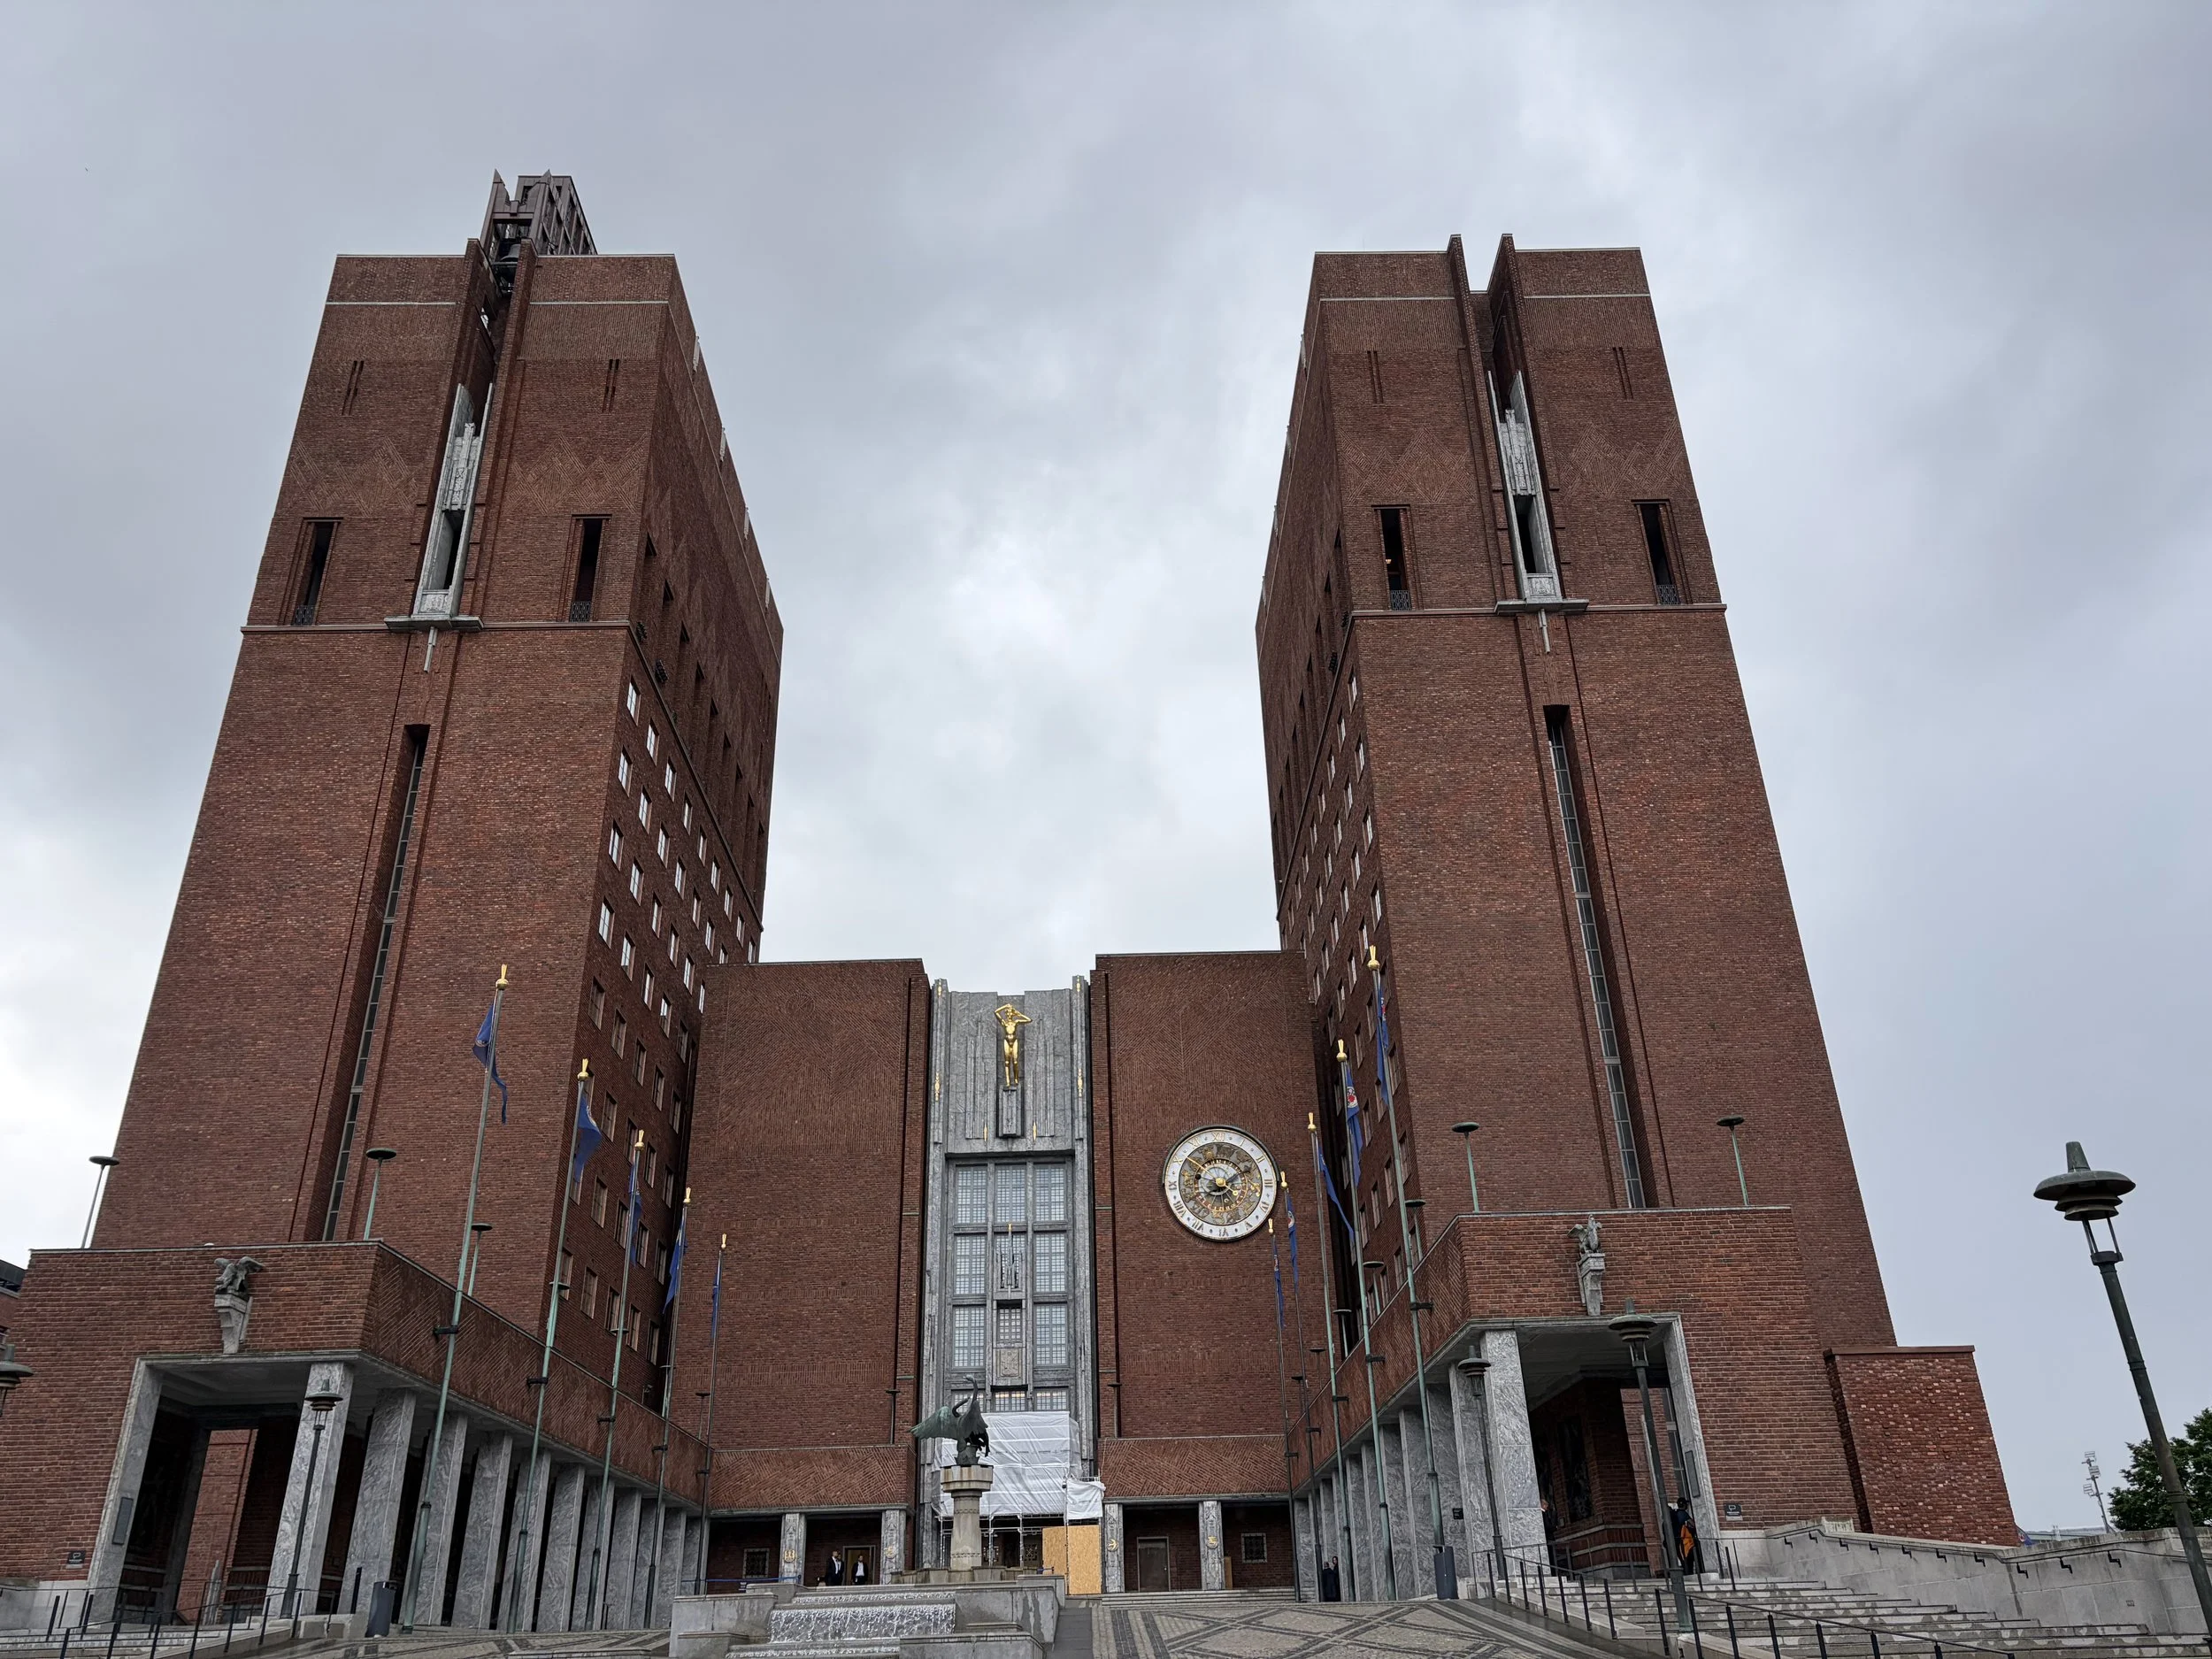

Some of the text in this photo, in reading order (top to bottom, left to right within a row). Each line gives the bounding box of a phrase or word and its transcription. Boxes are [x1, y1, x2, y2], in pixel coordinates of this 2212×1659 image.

[1172, 1156, 1184, 1165] X
[1168, 1180, 1178, 1190] IX
[1263, 1179, 1274, 1187] III
[1173, 1201, 1187, 1217] VIII
[1260, 1202, 1270, 1212] IV
[1218, 1227, 1229, 1237] VI
